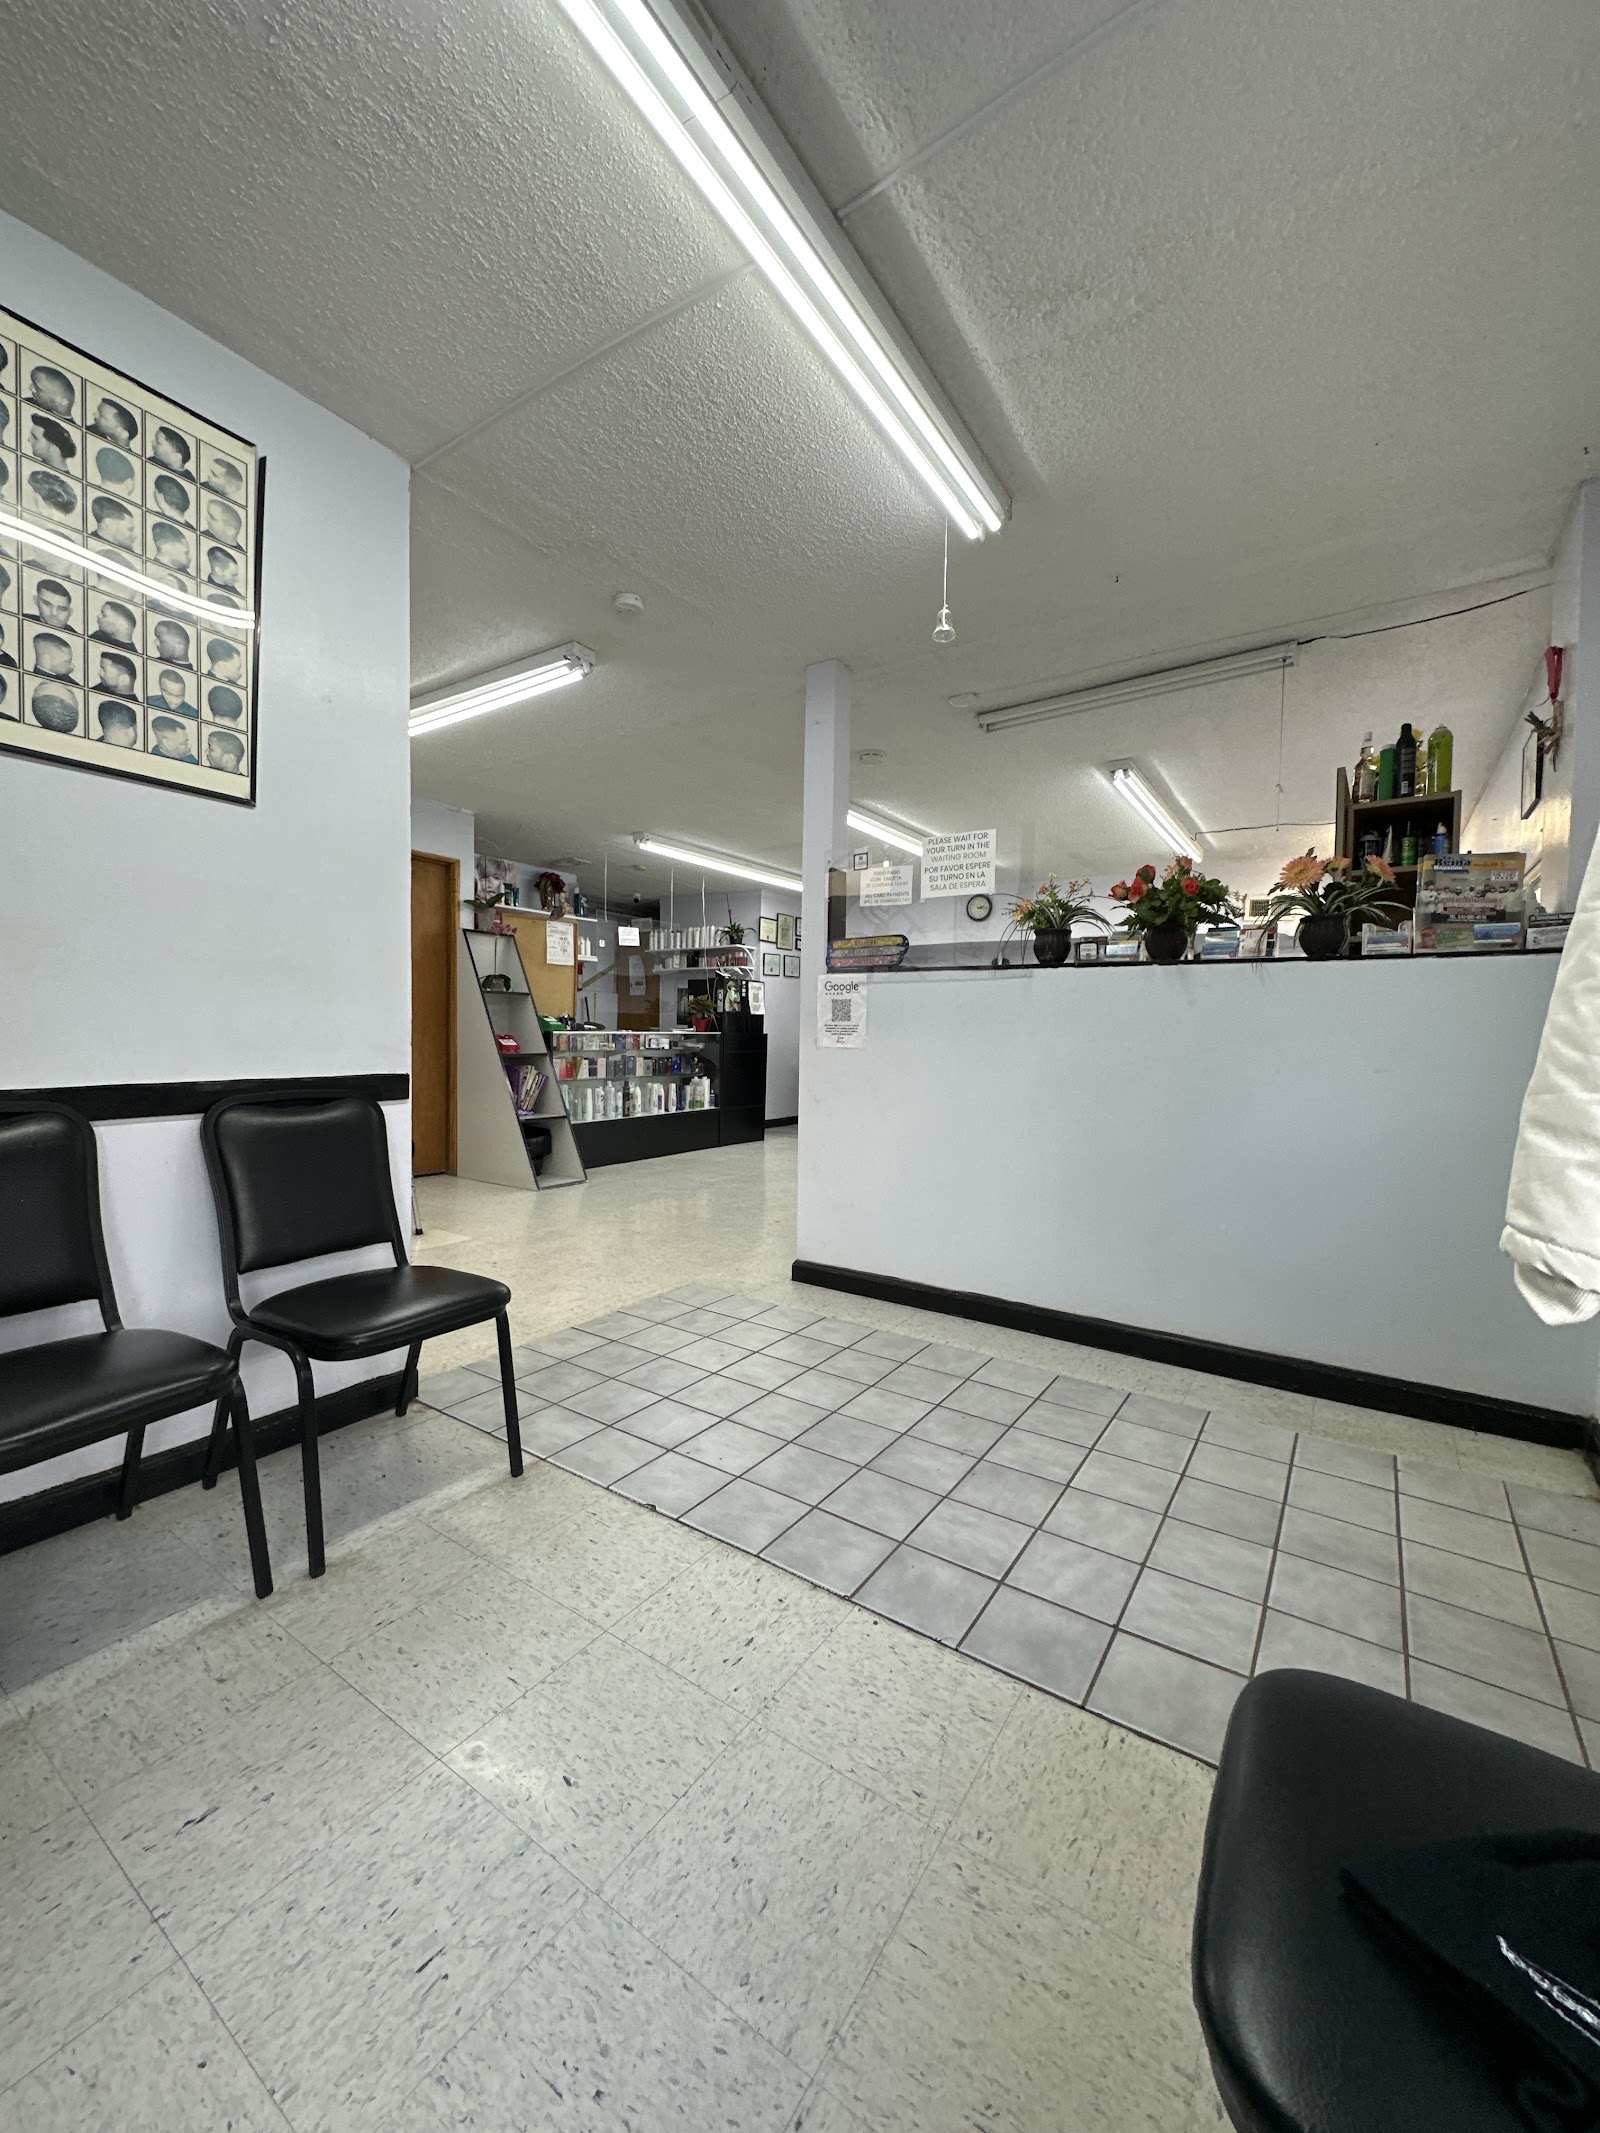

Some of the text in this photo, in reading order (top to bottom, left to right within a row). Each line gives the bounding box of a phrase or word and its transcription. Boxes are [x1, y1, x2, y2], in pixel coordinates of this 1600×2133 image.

[928, 836, 952, 845] PLEASE
[954, 834, 972, 842] WAIT
[947, 844, 966, 852] TURN
[931, 851, 986, 862] WAITING ROOM
[940, 864, 964, 872] FAVOR
[966, 861, 990, 870] ESPERE
[940, 873, 964, 881] TURNO
[930, 884, 948, 892] SALA
[960, 880, 986, 888] ESPERA
[824, 980, 859, 994] Google
